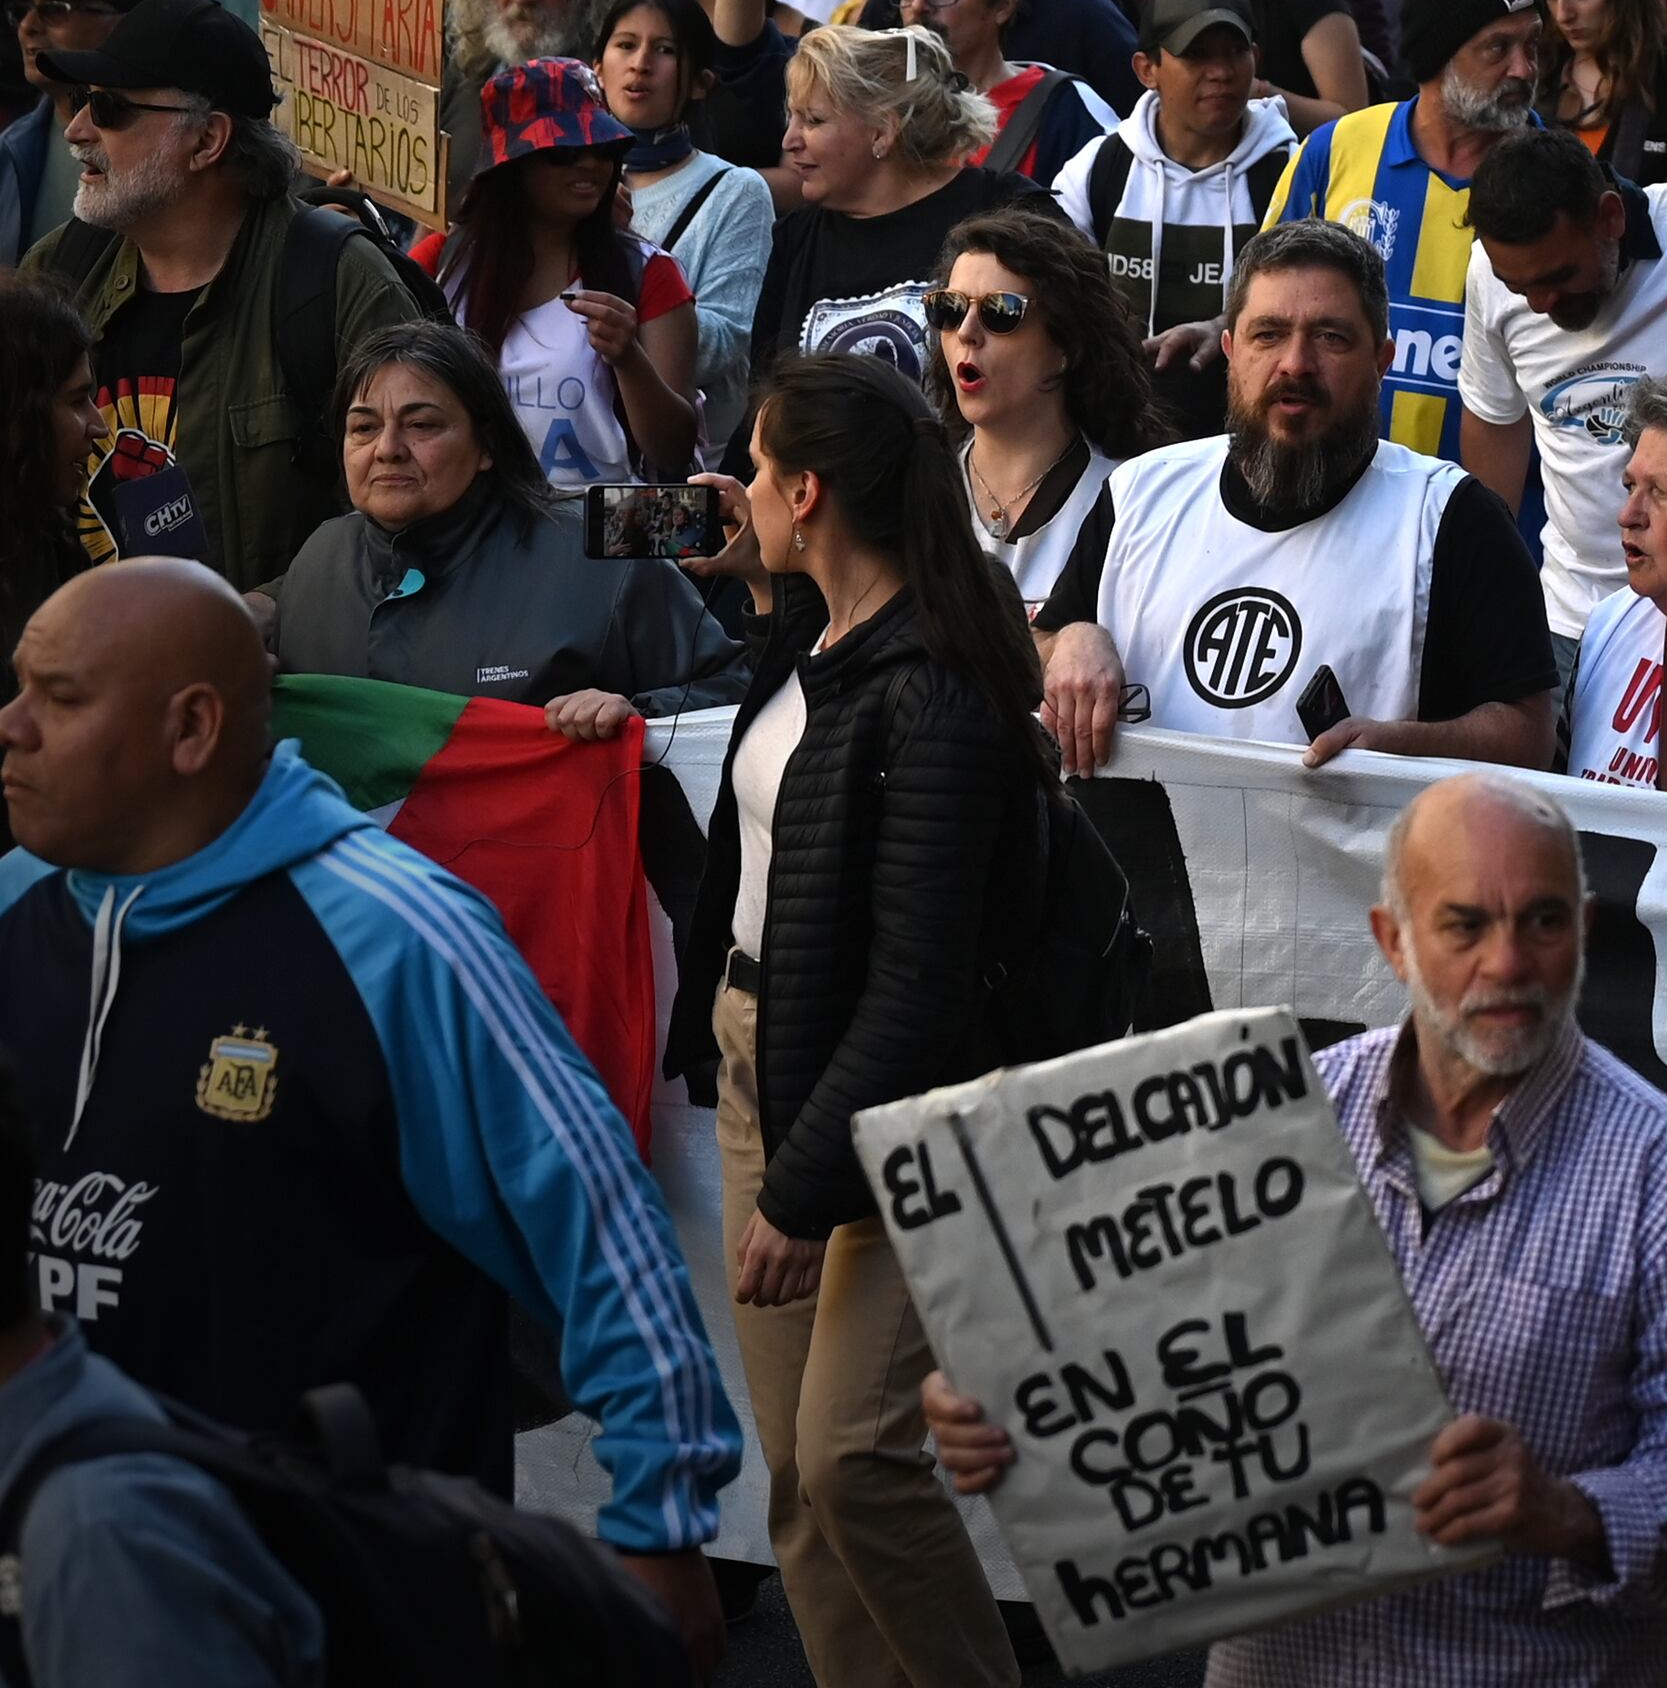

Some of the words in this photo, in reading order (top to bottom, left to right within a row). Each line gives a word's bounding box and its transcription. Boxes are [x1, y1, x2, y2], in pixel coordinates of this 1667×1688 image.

[261, 27, 293, 85] EL
[293, 37, 370, 116] TERROR
[375, 81, 391, 115] DE
[396, 95, 420, 127] LOS
[1543, 370, 1576, 389] WORLD
[1576, 362, 1647, 378] CHAMPIONSHIP
[481, 669, 529, 683] ARGENTINOS
[1197, 599, 1290, 695] ATE
[216, 1062, 258, 1100] AFA
[882, 1141, 962, 1231] EL
[1065, 1157, 1305, 1293] METELO
[28, 1252, 124, 1321] PF
[1014, 1348, 1136, 1439] EN
[1158, 1311, 1285, 1389] EL
[1069, 1371, 1301, 1487] COÑO
[1110, 1465, 1210, 1533] DE
[1211, 1422, 1312, 1499] TU
